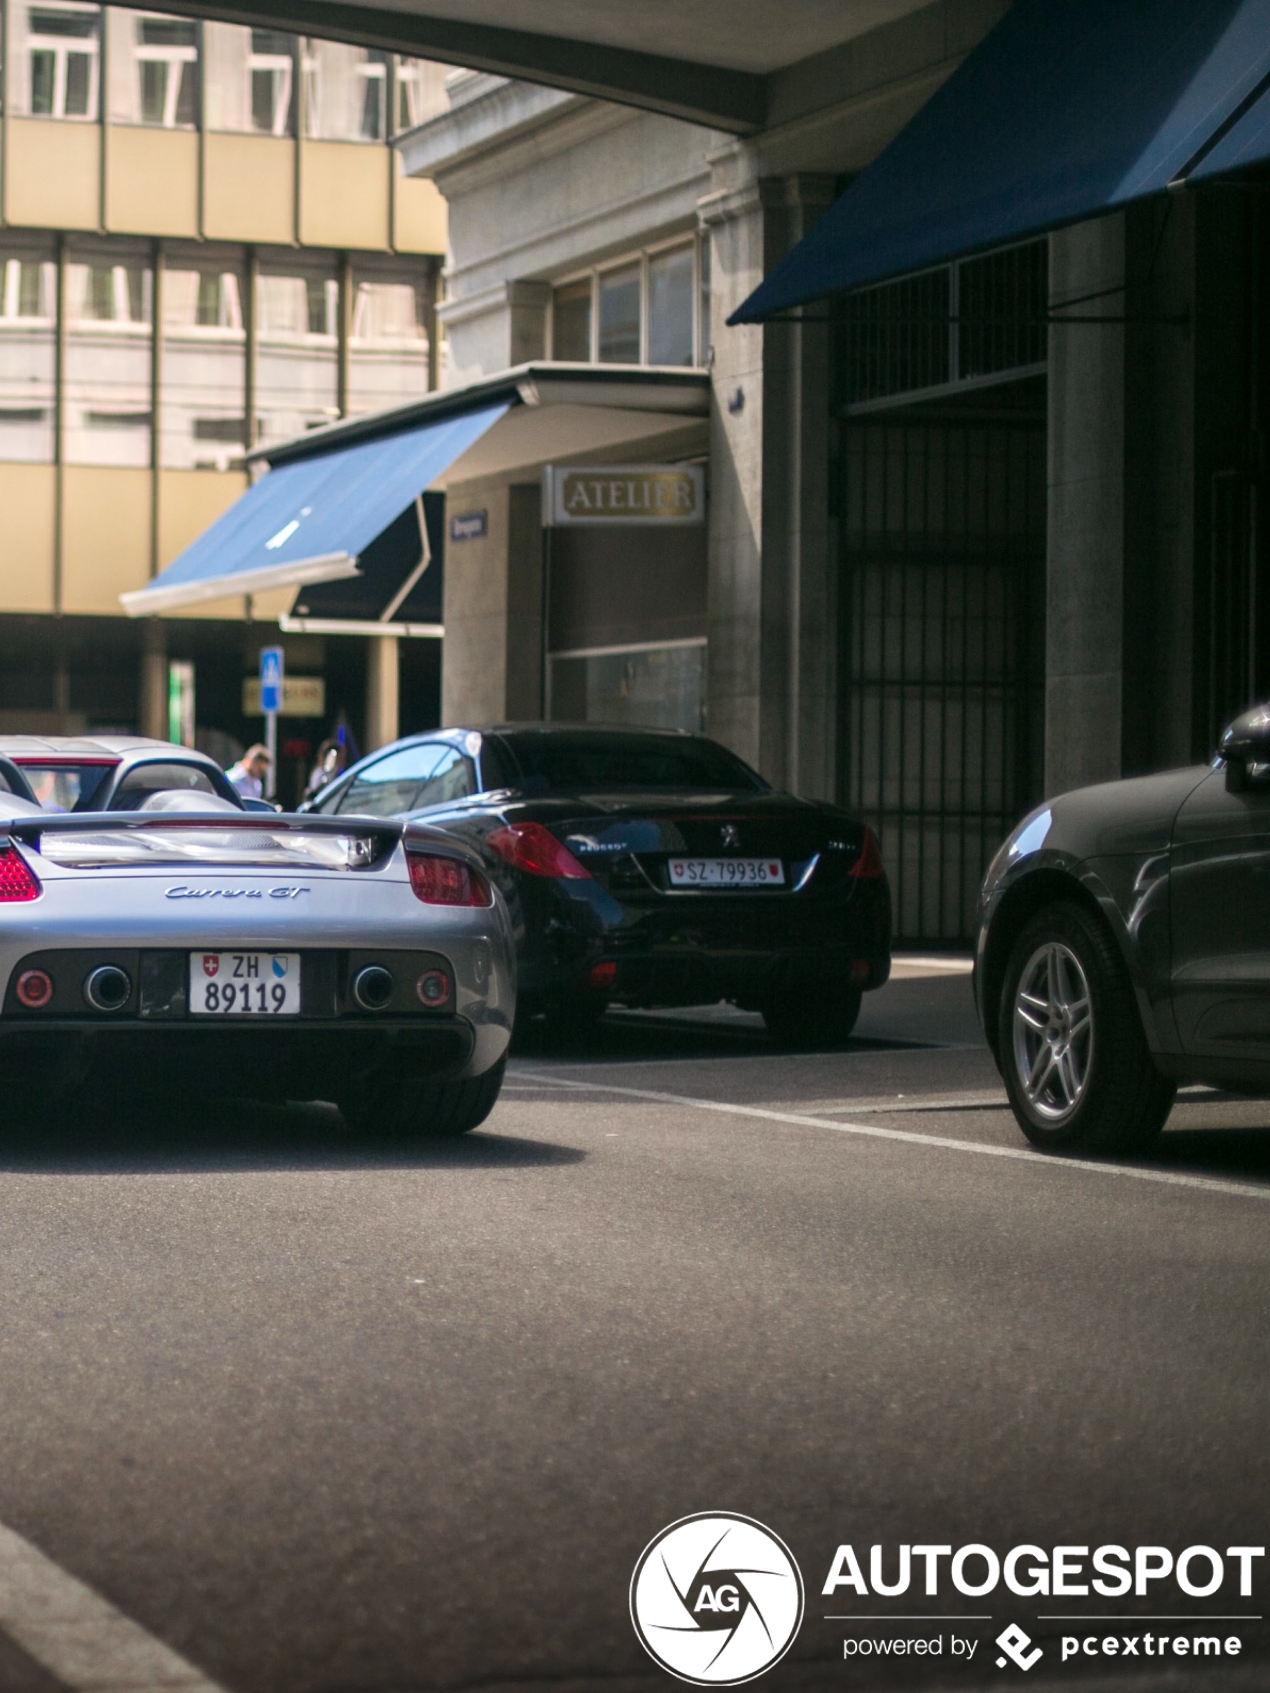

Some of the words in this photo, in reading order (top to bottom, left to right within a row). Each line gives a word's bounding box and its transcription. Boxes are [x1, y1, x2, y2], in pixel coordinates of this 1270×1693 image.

[568, 480, 692, 509] ATELIER
[164, 886, 262, 899] Carrera
[267, 887, 310, 899] GT
[232, 956, 259, 978] ZH
[204, 982, 286, 1013] 89119
